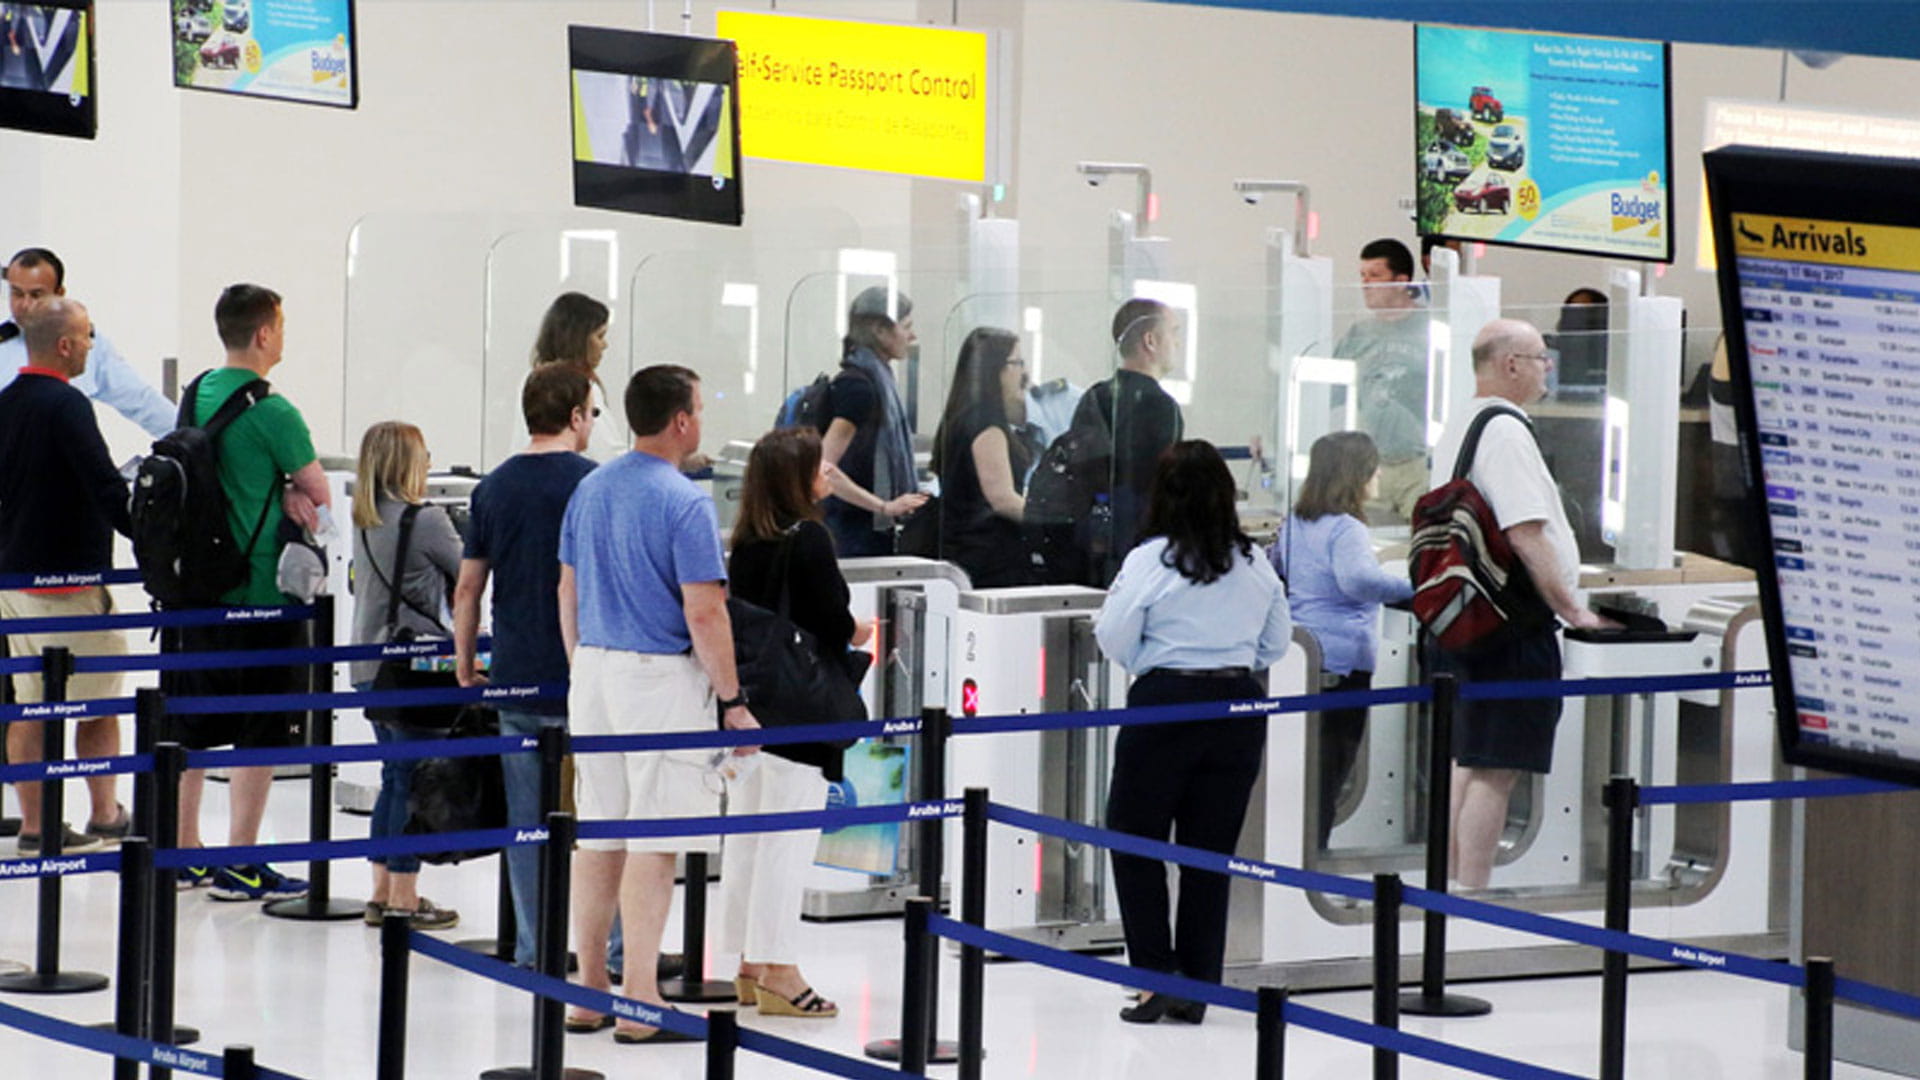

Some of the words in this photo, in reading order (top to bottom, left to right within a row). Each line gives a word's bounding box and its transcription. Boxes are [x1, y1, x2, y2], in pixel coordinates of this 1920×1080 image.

[737, 51, 823, 86] elf-Service
[829, 61, 905, 97] Passport
[909, 67, 977, 101] Control
[1610, 192, 1661, 224] Budget
[1772, 224, 1868, 257] Arrivals
[1803, 267, 1822, 282] May
[34, 574, 64, 586] Aruba
[66, 572, 102, 586] Airport
[226, 610, 250, 618] Aruba
[252, 608, 282, 618] Airport
[382, 645, 406, 655] Aruba
[408, 643, 438, 654] Airport
[1735, 674, 1763, 685] Aruba
[482, 687, 507, 697] Aruba
[510, 686, 539, 697] Airport
[22, 704, 52, 717] Aruba
[54, 703, 87, 716] Airport
[1229, 702, 1252, 714] Aruba
[1254, 701, 1280, 713] Airport
[882, 720, 916, 734] Aruba
[521, 738, 538, 748] Aru
[46, 763, 75, 776] Aruba
[77, 761, 111, 774] Airport
[909, 804, 942, 818] Aruba
[944, 802, 965, 816] Airp
[0, 860, 38, 875] Aruba
[40, 858, 87, 874] Airport
[1228, 860, 1249, 873] Aruba
[1250, 864, 1276, 879] Airport
[1672, 946, 1696, 961] Aruba
[1698, 950, 1726, 968] Airport
[612, 1000, 636, 1016] Aruba
[638, 1004, 662, 1026] Airport
[152, 1046, 177, 1064] Aruba
[180, 1050, 208, 1072] Airport
